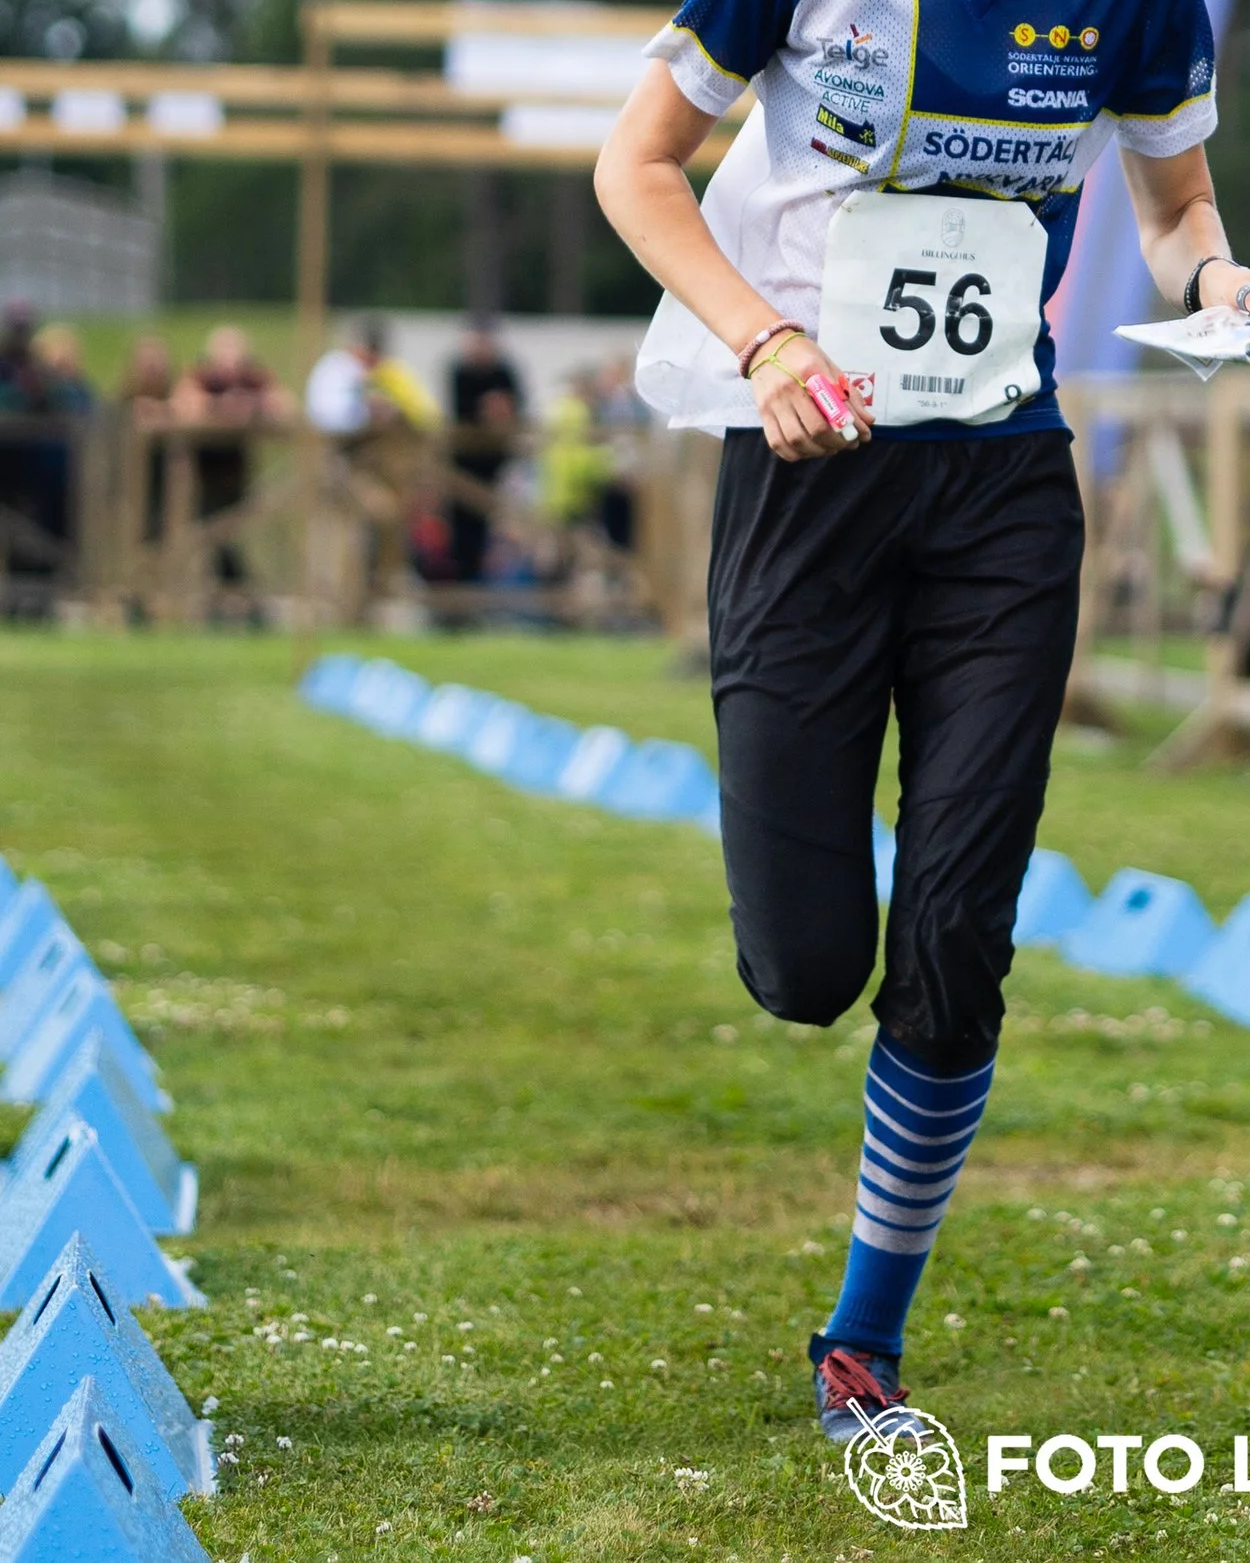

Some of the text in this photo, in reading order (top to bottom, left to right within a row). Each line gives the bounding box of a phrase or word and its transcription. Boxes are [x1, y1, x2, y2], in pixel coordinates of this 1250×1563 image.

[816, 37, 890, 71] Telge
[1007, 60, 1096, 77] ORIENTERING
[814, 69, 885, 97] AVONOVA
[821, 90, 872, 113] ACTIVE
[1007, 87, 1089, 109] SCANIA
[817, 105, 845, 135] Mila
[879, 267, 993, 356] 56
